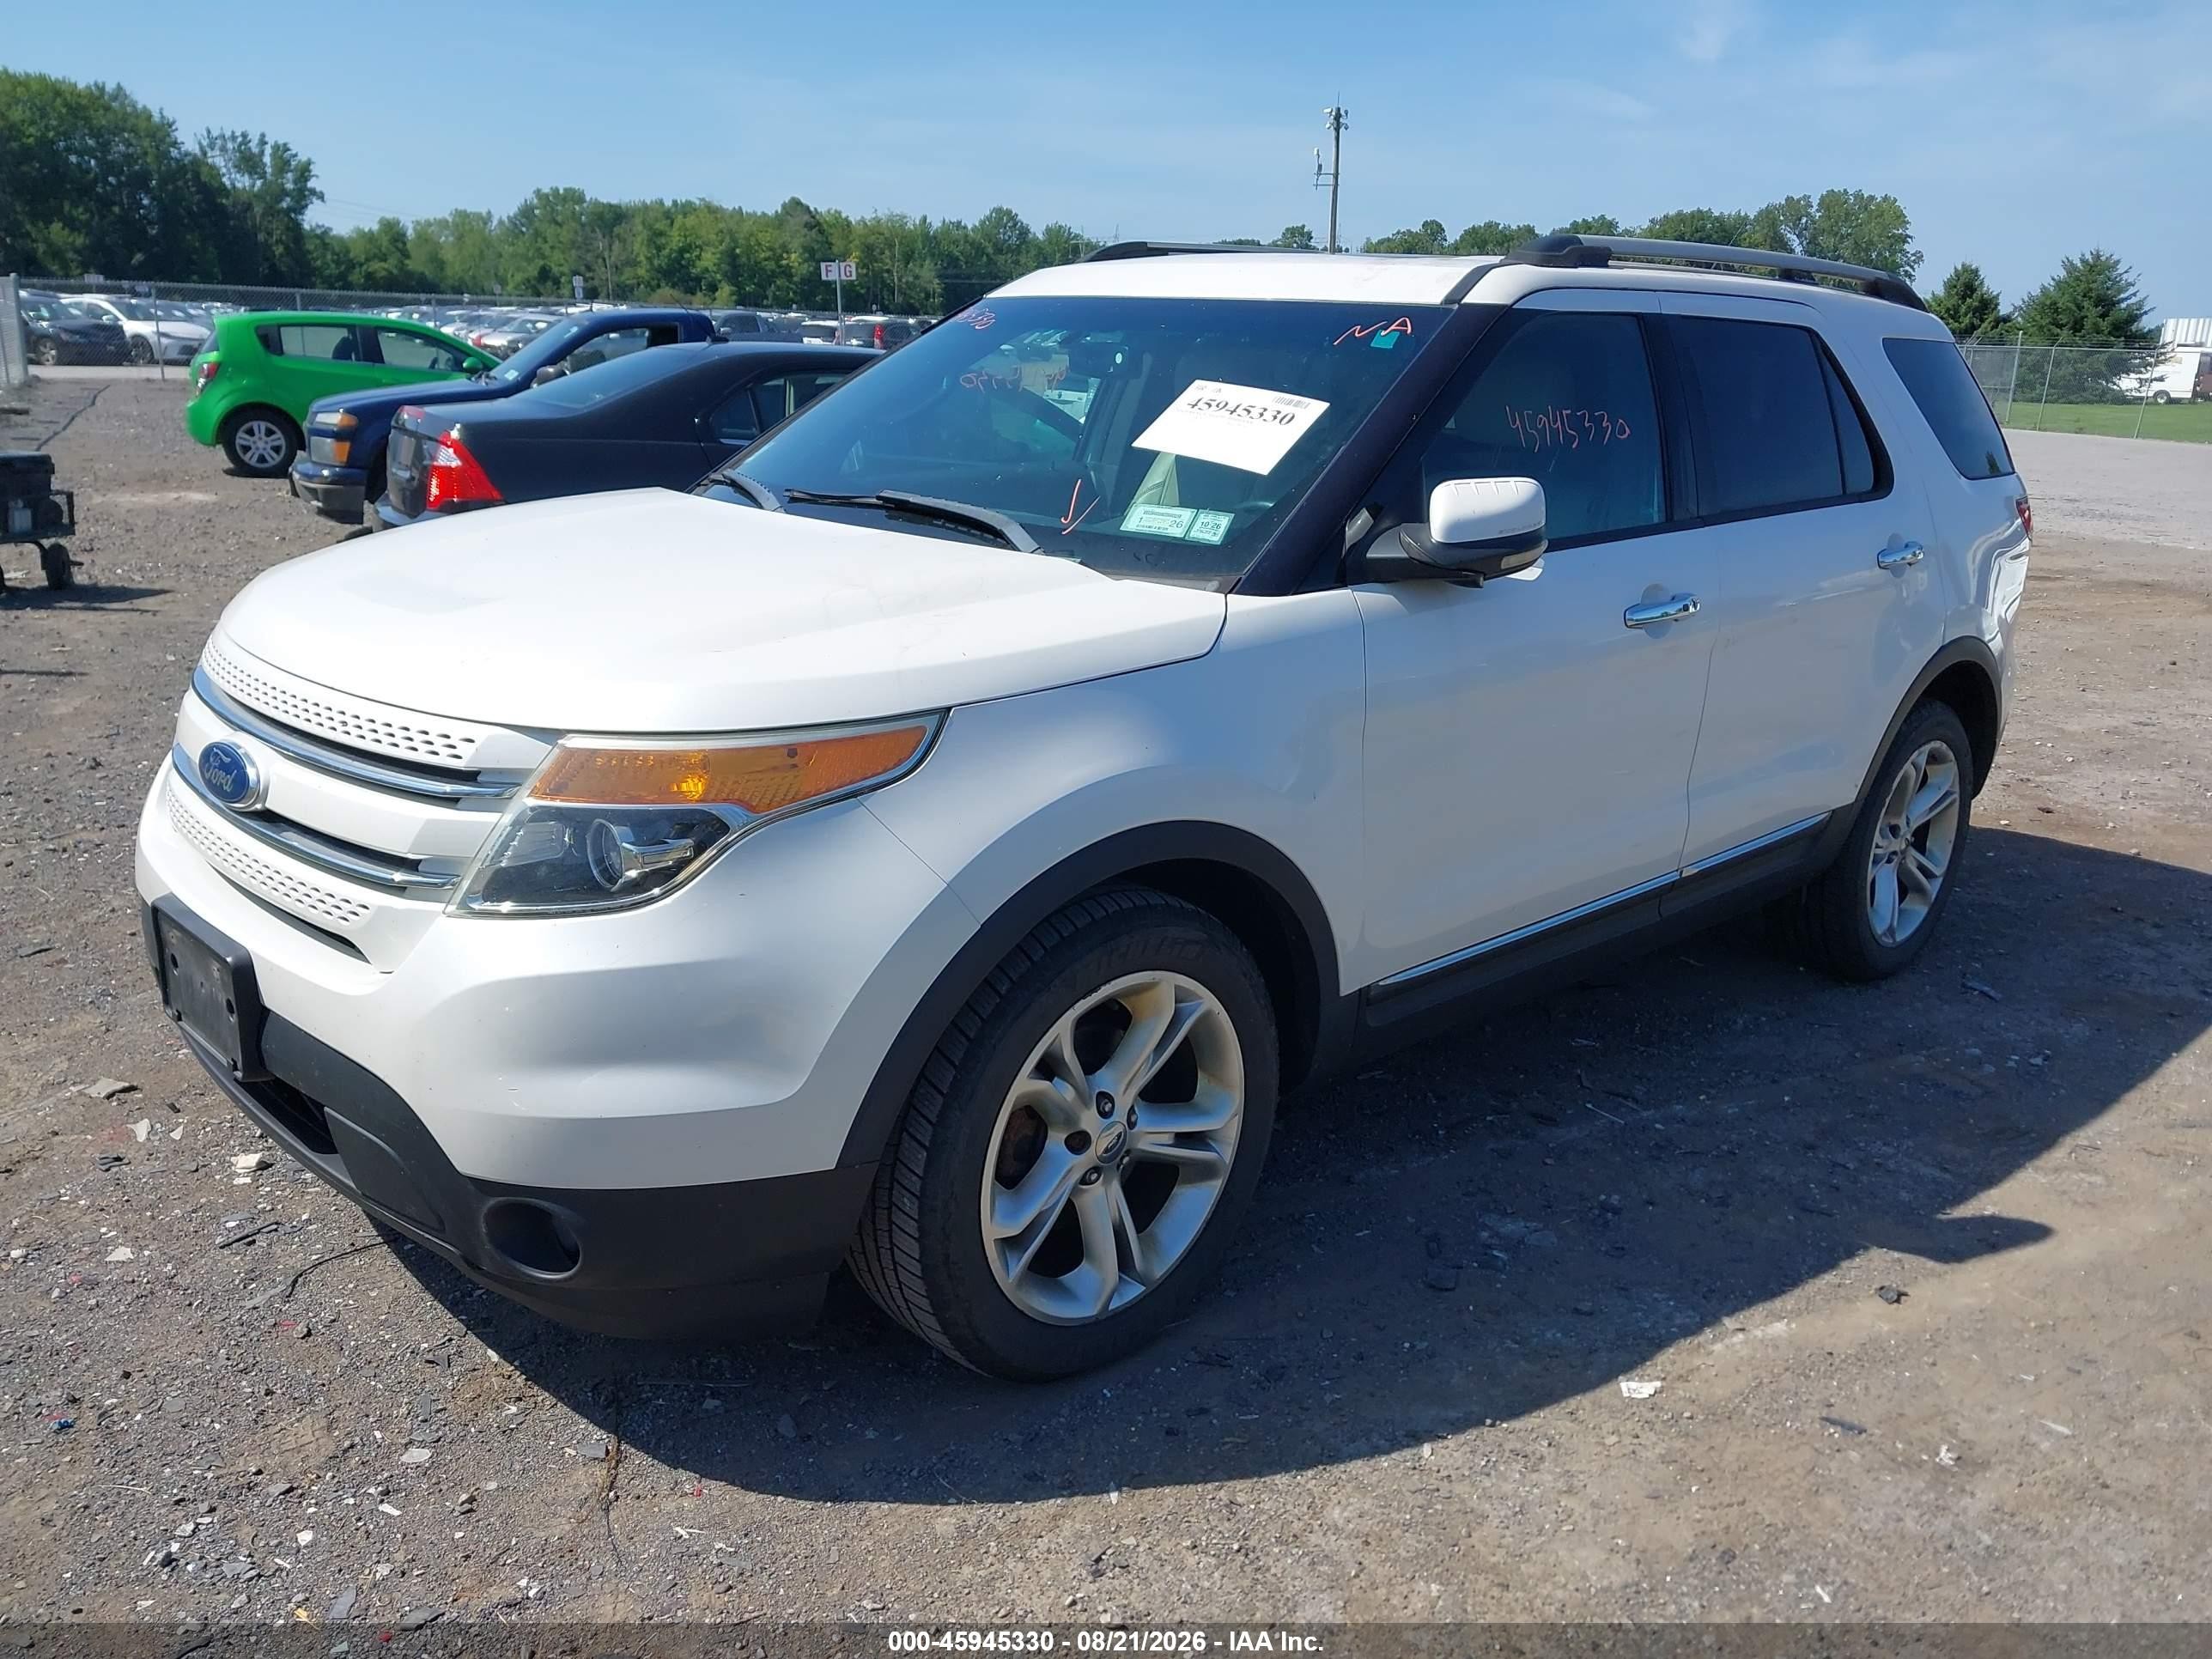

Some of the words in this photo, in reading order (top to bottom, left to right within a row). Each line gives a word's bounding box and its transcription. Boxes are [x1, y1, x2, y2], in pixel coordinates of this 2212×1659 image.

[824, 264, 832, 278] F
[844, 264, 853, 278] G
[1187, 397, 1296, 426] 45945330
[1505, 405, 1632, 453] 45945330
[1168, 520, 1184, 529] 26
[204, 747, 237, 792] Ford
